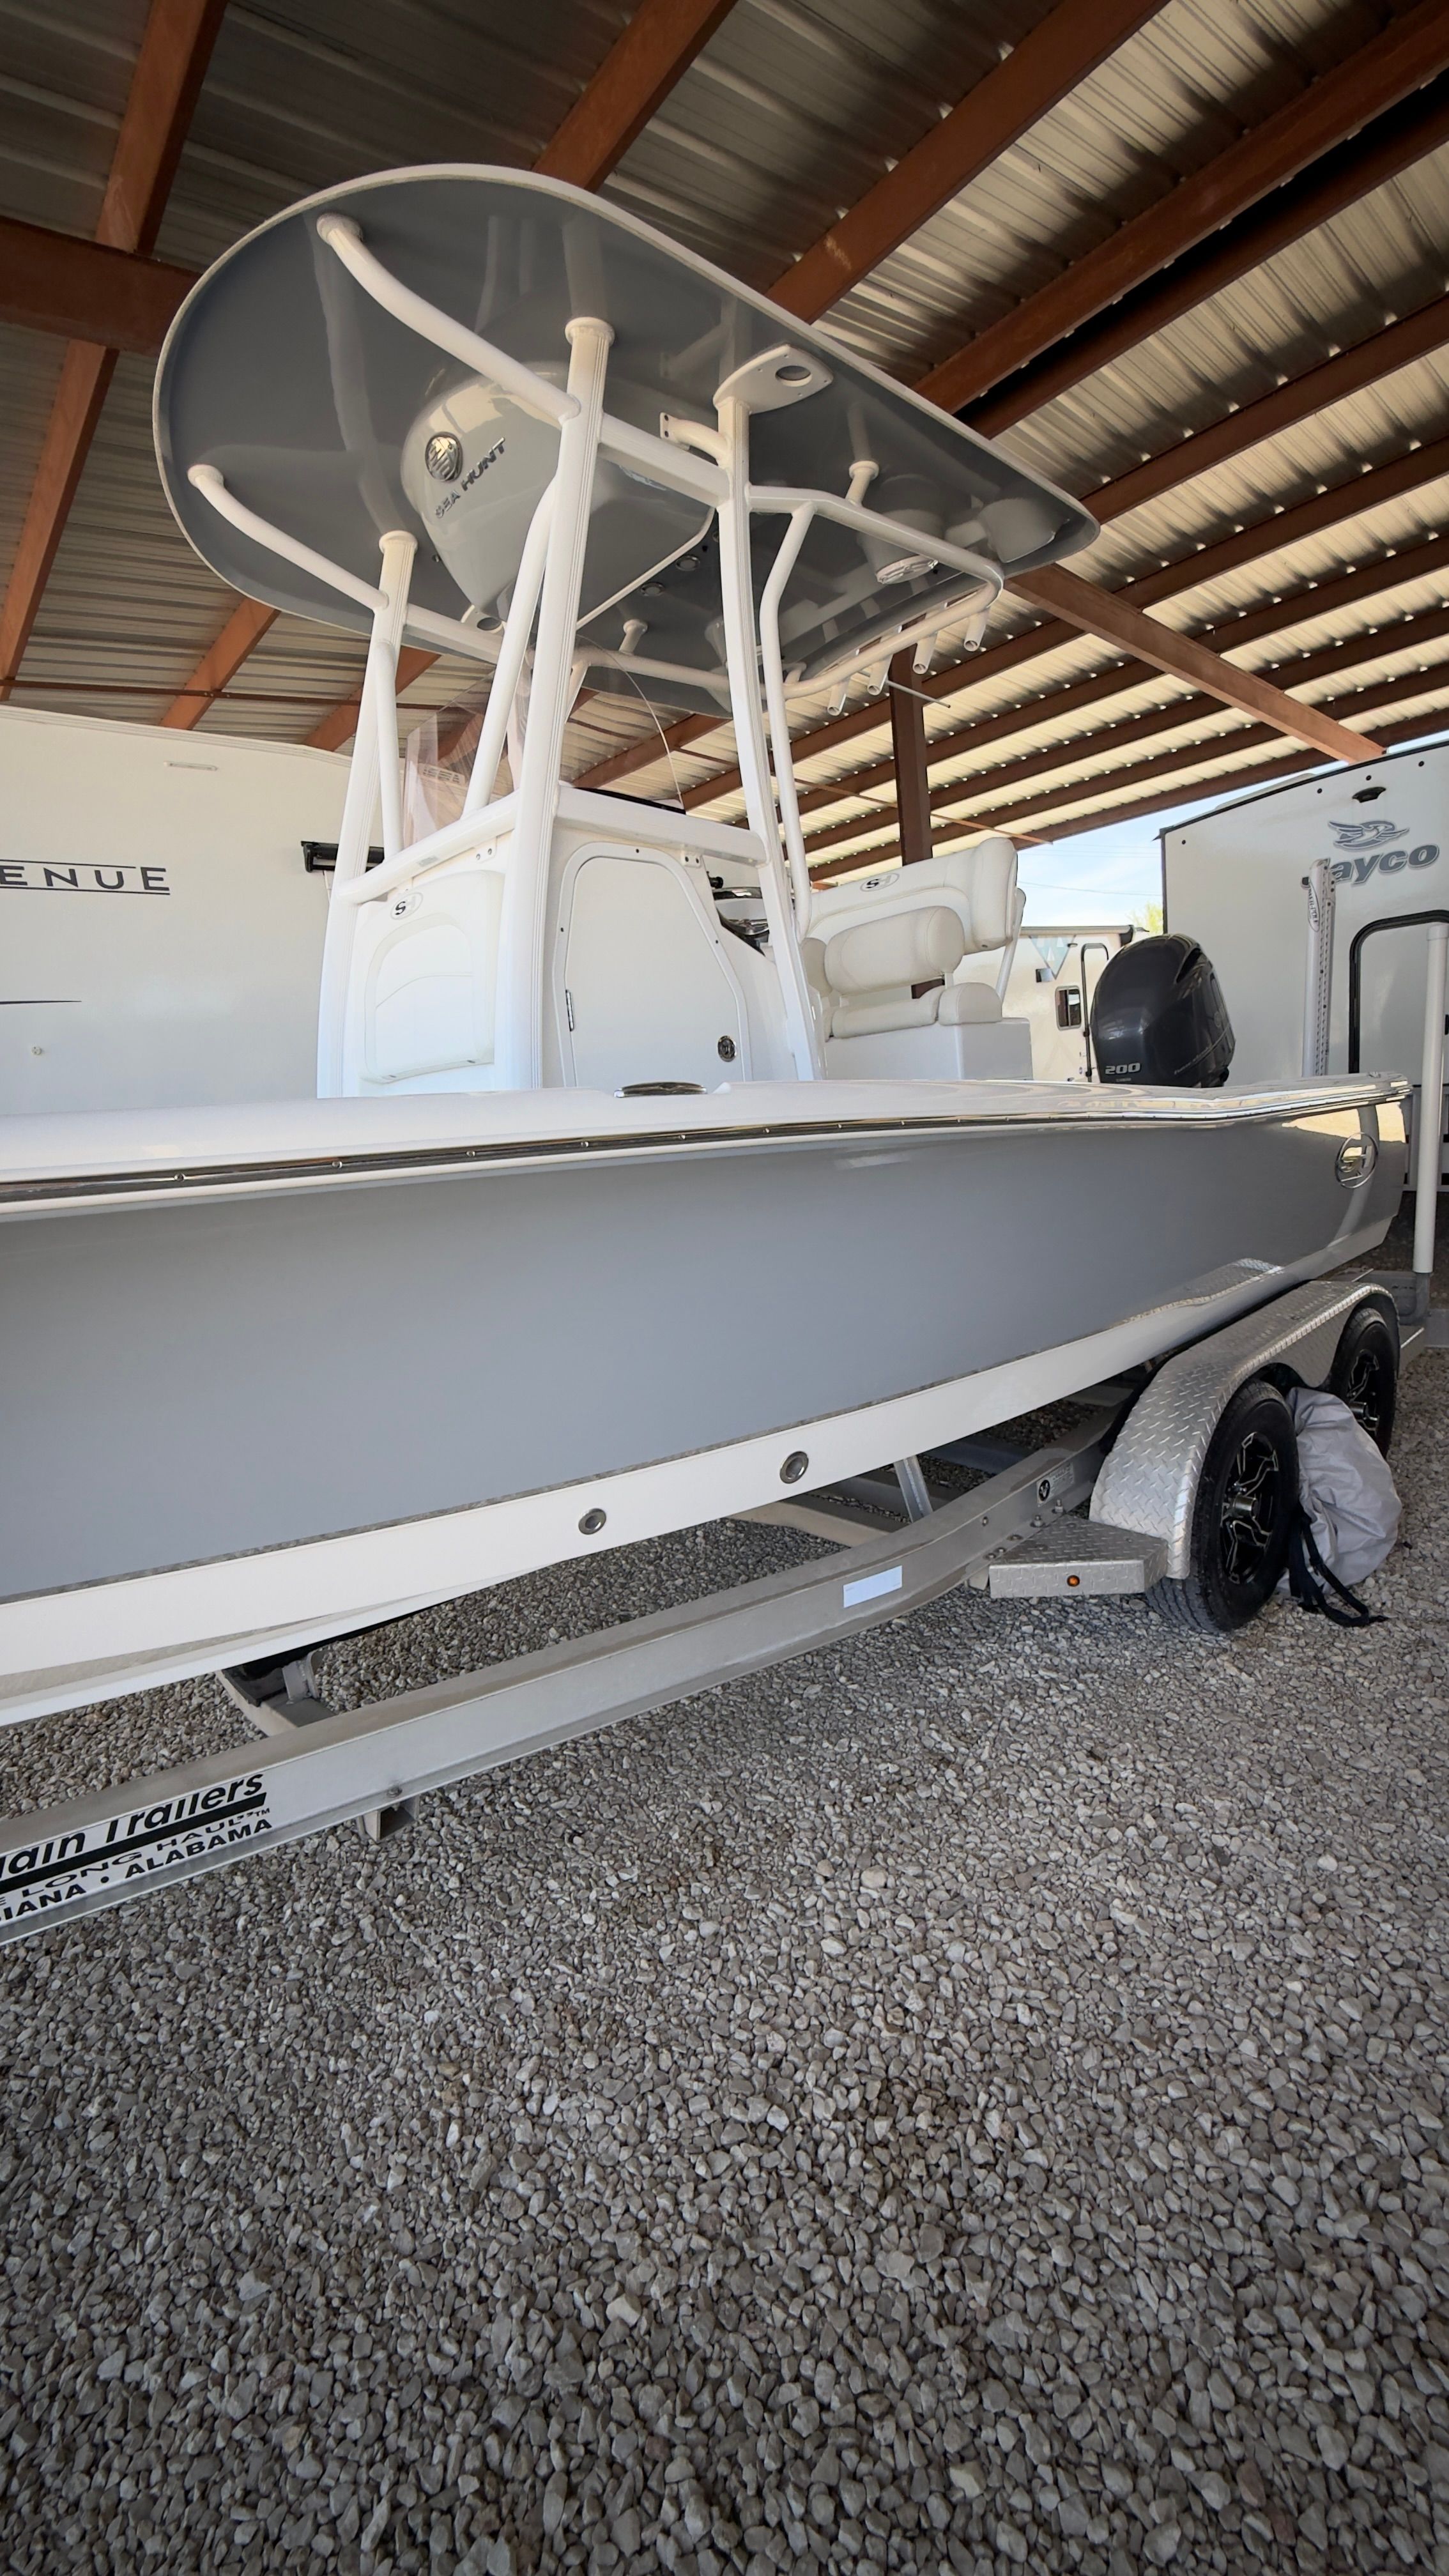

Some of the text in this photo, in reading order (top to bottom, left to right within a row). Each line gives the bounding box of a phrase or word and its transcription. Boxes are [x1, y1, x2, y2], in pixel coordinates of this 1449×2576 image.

[435, 436, 505, 518] SEA HUNT
[1301, 844, 1440, 887] ayco
[1105, 1062, 1141, 1075] 200
[0, 1819, 273, 1920] IANA ALABAMA
[22, 1851, 142, 1897] LONG
